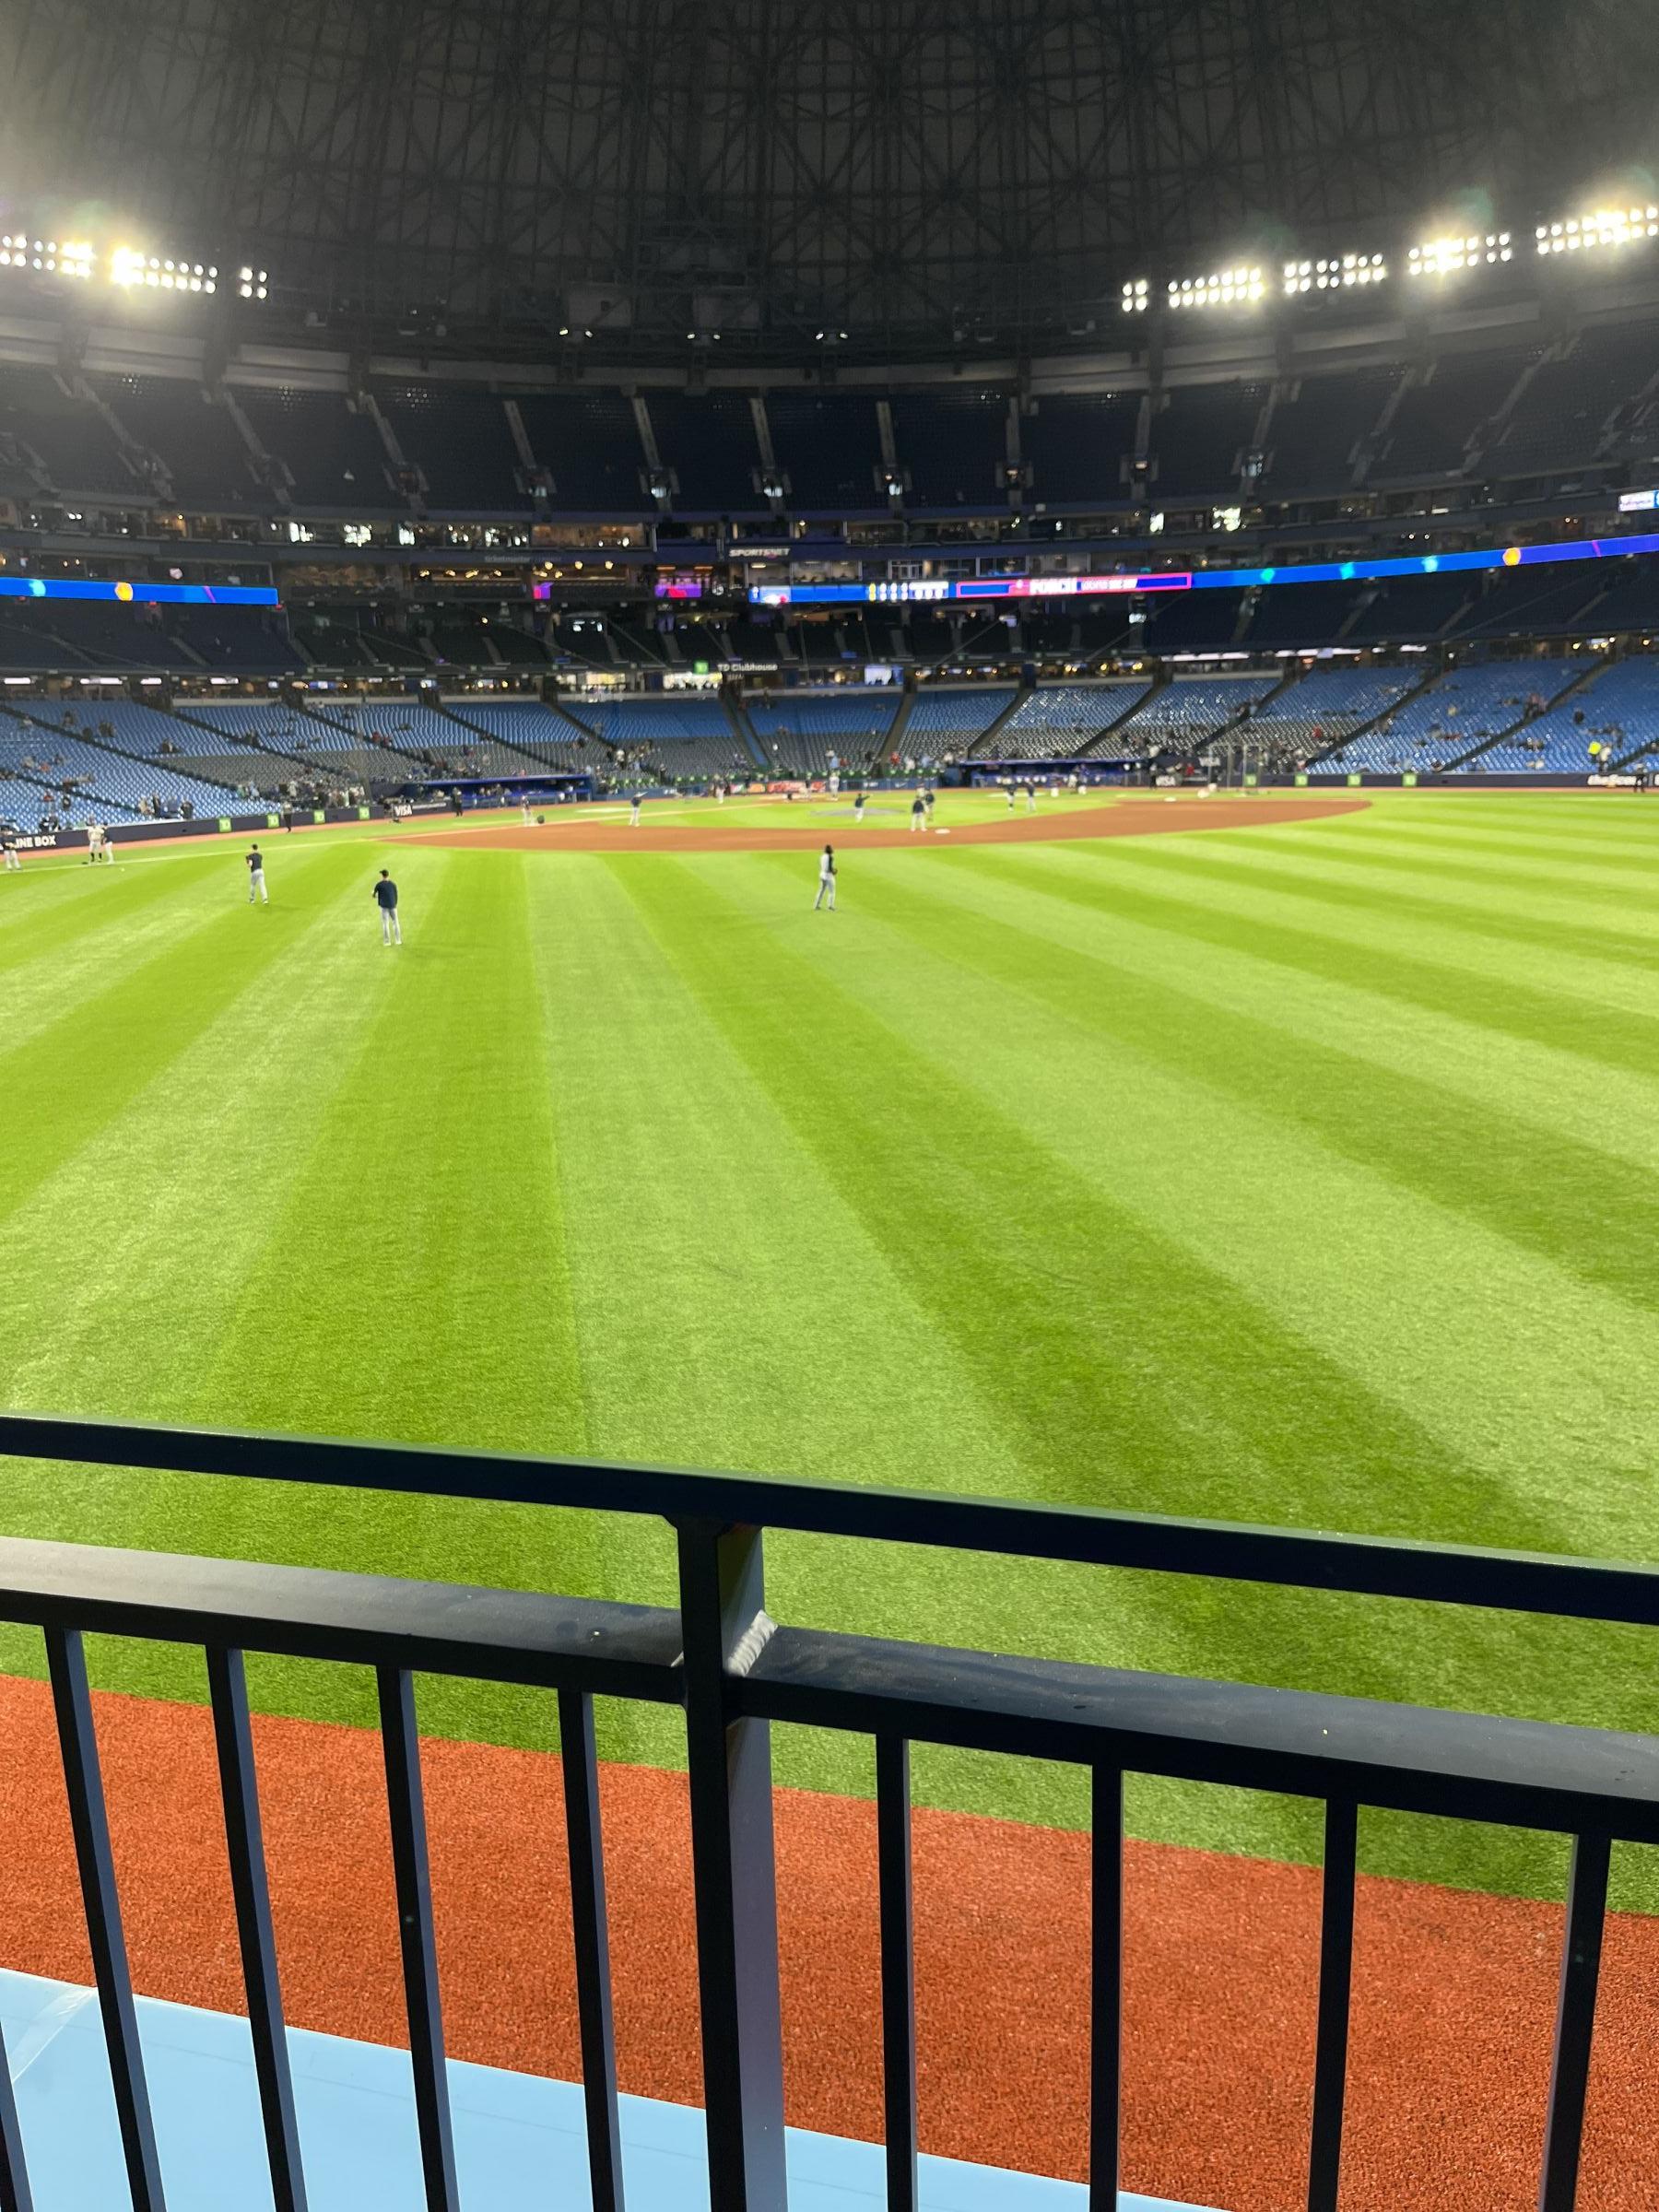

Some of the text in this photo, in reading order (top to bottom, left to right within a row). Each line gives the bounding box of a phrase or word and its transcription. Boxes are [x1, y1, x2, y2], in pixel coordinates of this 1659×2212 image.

[717, 663, 778, 672] TD Clubhouse
[394, 804, 412, 817] VISA
[34, 834, 56, 847] BOX
